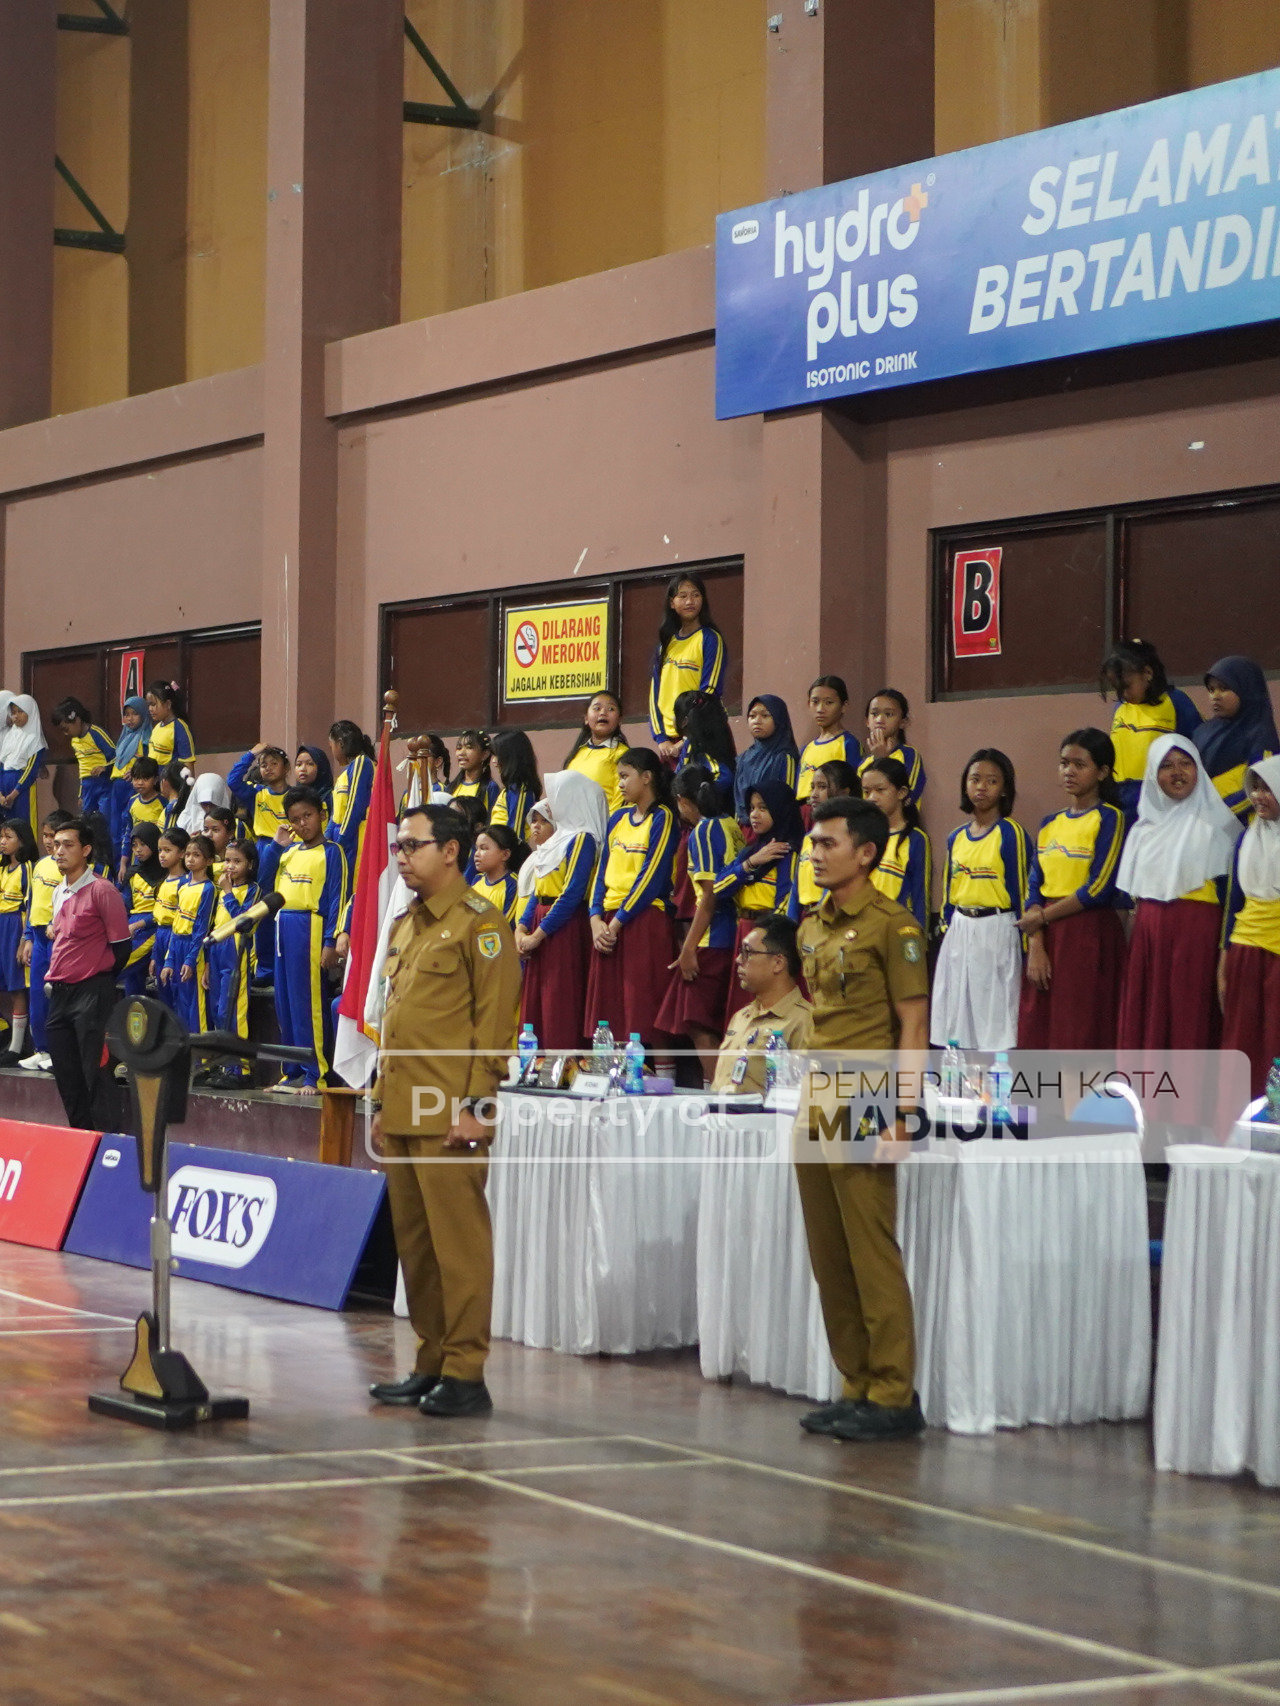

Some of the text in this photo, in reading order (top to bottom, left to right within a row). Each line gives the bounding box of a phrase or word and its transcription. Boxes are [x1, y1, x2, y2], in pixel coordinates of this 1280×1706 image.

[1021, 110, 1280, 236] SELAMA
[774, 187, 920, 291] hydro
[968, 205, 1280, 334] BERTANDI
[806, 270, 919, 361] plus
[806, 350, 918, 388] ISOTONIC DRINK
[542, 615, 601, 640] DILARANG
[961, 559, 994, 635] B
[124, 656, 140, 702] A
[510, 671, 602, 693] JAGALAH KEBERSIHAN
[541, 640, 600, 664] MEROKOK
[170, 1184, 265, 1248] FOX'S
